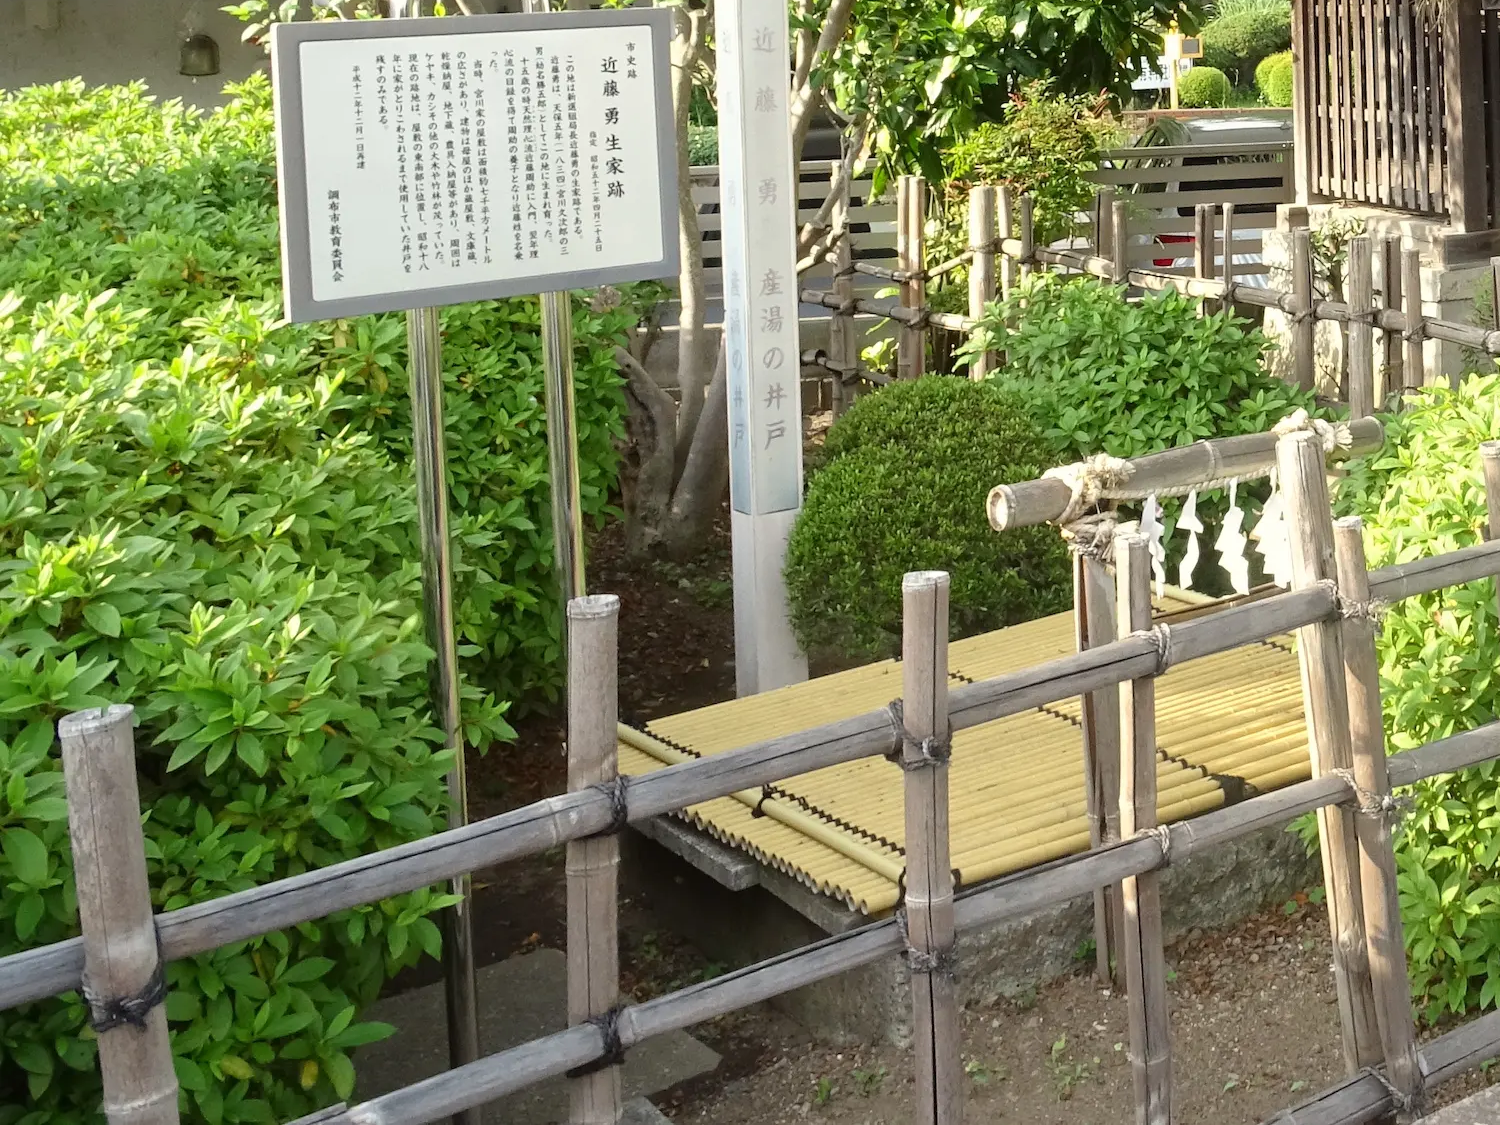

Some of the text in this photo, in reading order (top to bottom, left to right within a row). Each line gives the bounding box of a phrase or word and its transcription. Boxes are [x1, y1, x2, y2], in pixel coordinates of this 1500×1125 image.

[625, 41, 637, 79] 市史跡
[352, 65, 365, 169] 平成十二年十二月一日再建
[600, 55, 625, 198] 近藤勇生家跡
[327, 189, 344, 282] 調布市教育委員会
[588, 130, 602, 252] 指定 昭和五十二年四月二十五日
[757, 177, 778, 206] 勇
[758, 267, 787, 451] 産湯の井戸
